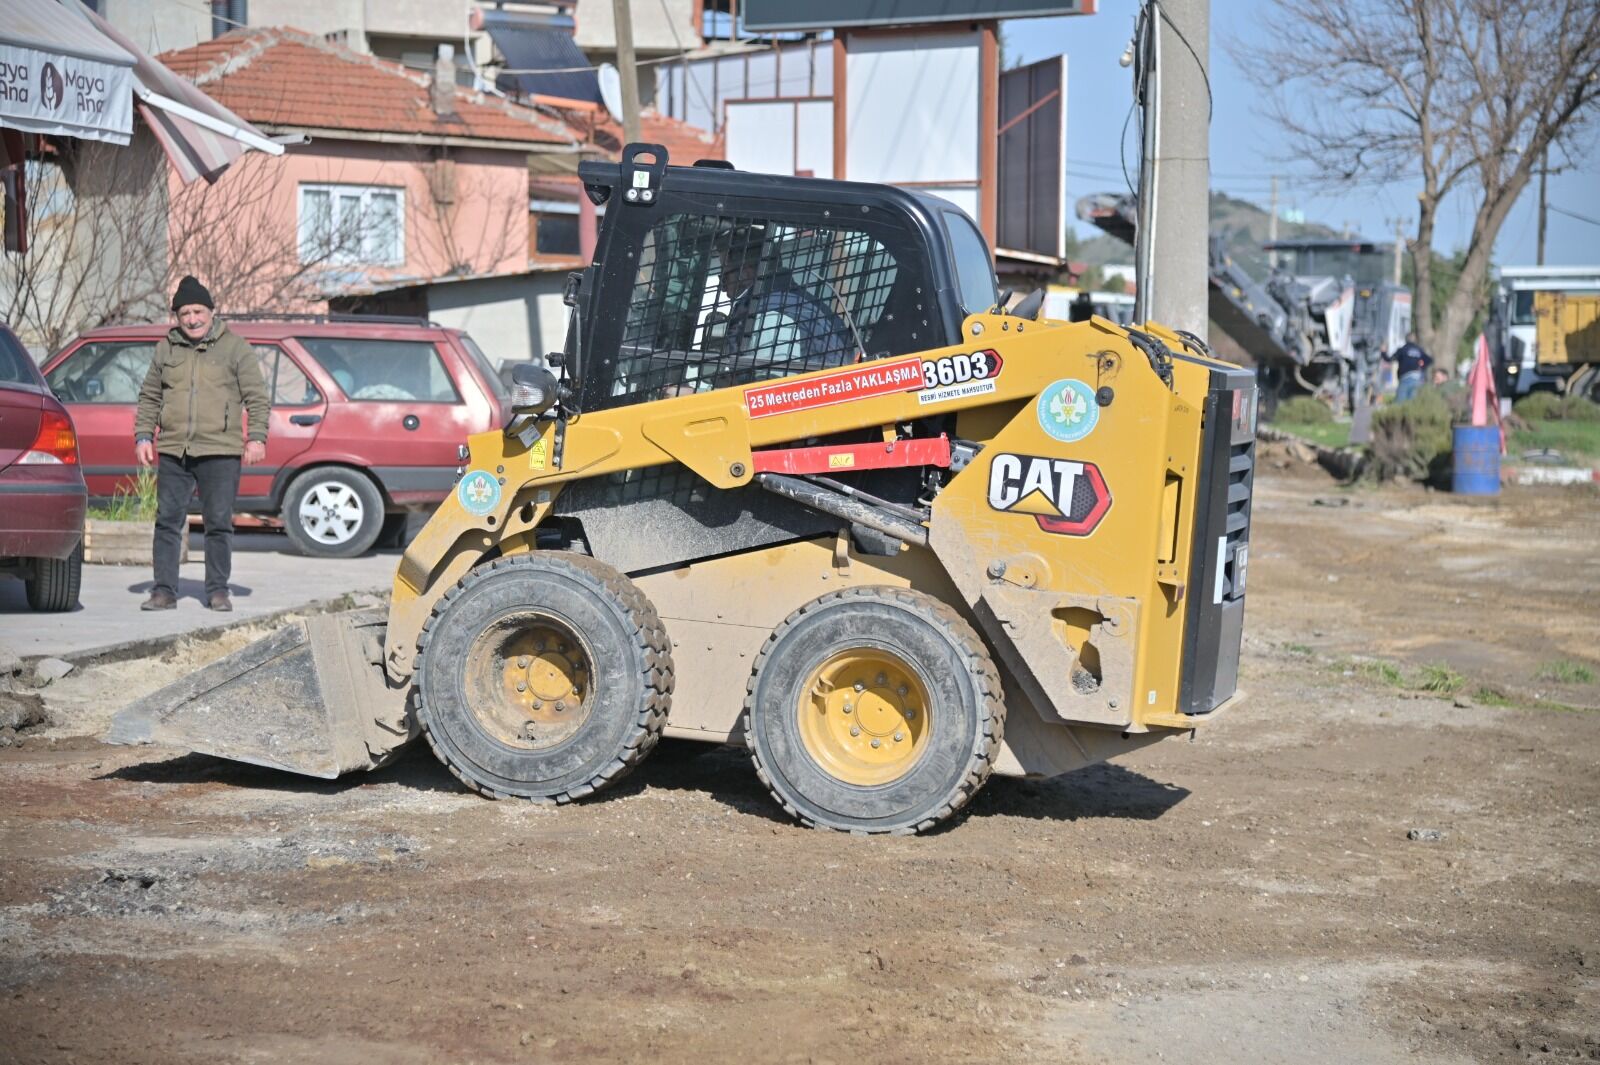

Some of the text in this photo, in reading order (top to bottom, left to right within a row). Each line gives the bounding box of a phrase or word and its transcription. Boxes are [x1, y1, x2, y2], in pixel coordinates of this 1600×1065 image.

[65, 68, 105, 95] Maya
[77, 92, 105, 113] Ana
[750, 365, 919, 410] 25 Metreden Fazla YAKLAŞMA
[922, 351, 989, 388] 36D3
[989, 453, 1084, 517] CAT
